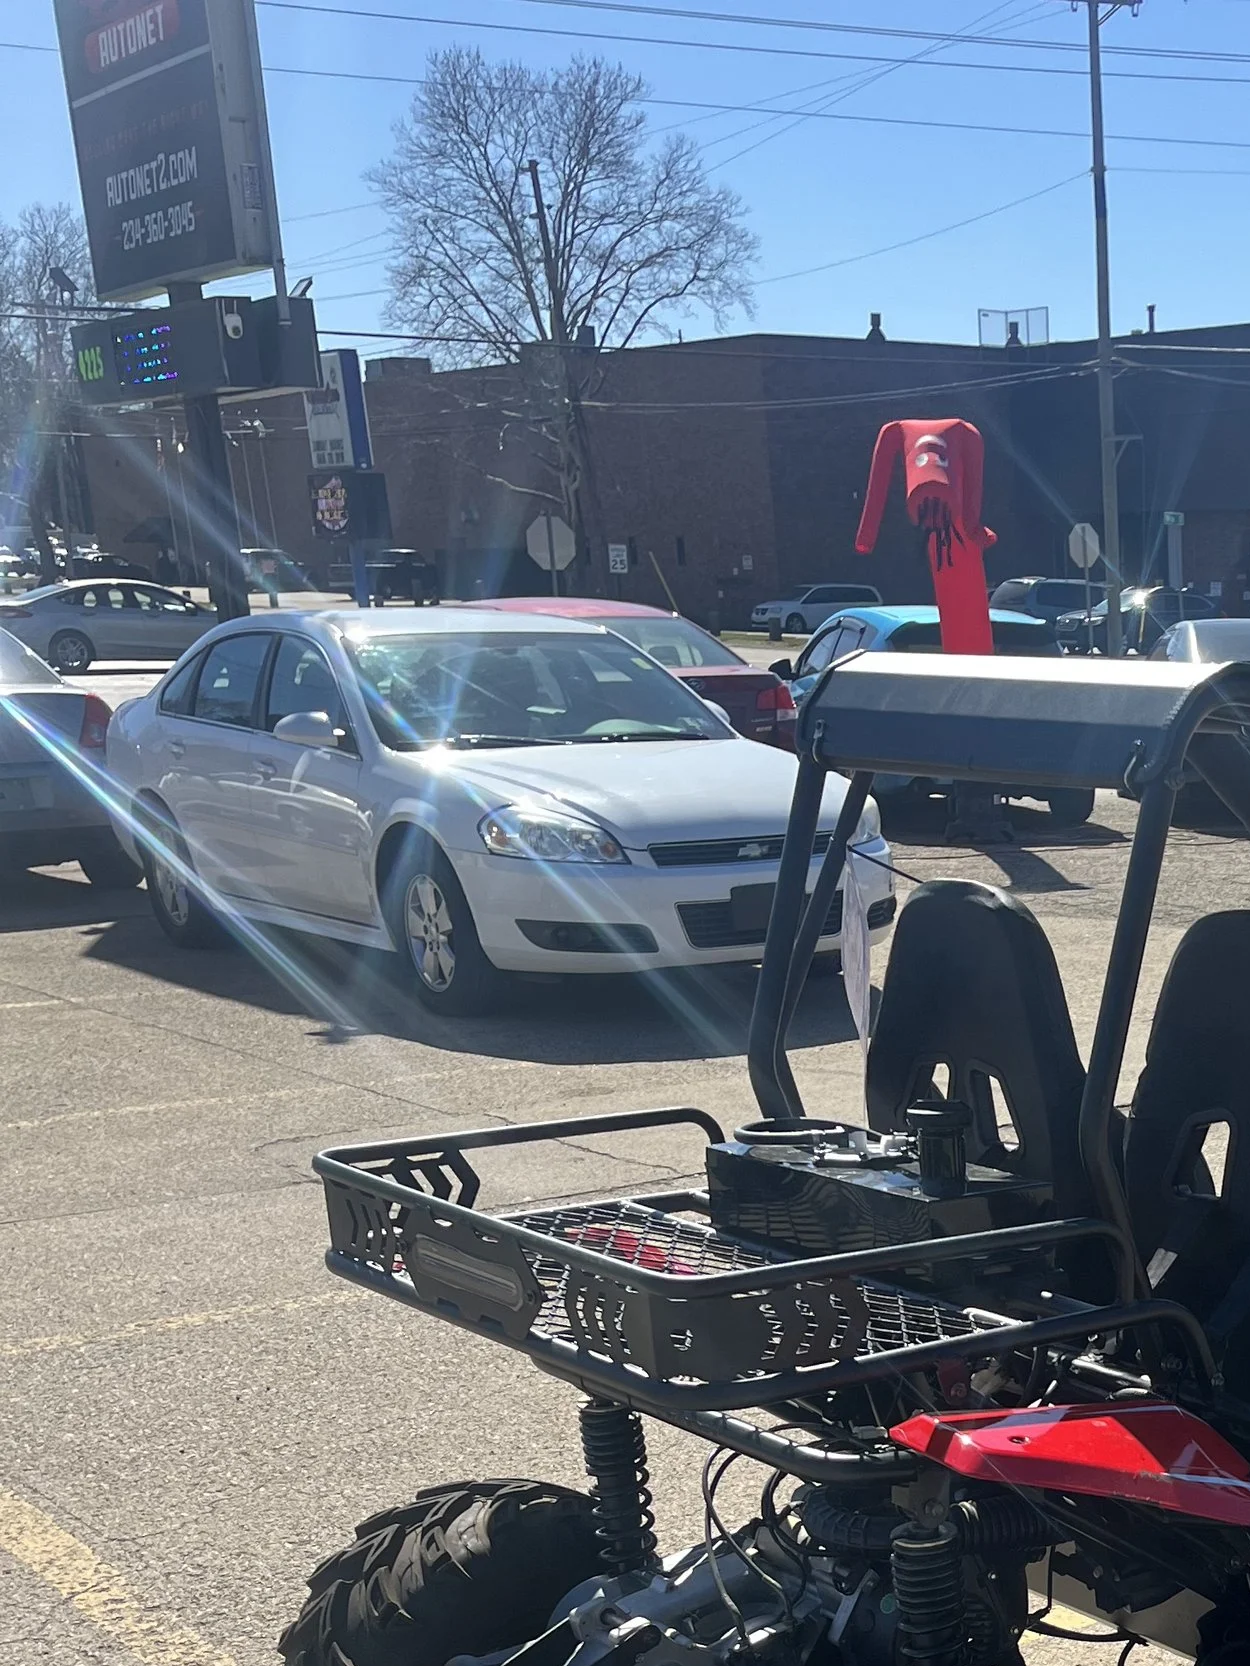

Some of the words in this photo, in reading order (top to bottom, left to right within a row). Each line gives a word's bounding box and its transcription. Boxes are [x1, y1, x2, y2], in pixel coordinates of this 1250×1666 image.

[98, 4, 165, 68] AUTONET
[106, 146, 198, 208] AUTONET2.COM
[122, 200, 196, 250] 234-360-3045
[611, 558, 626, 570] 25
